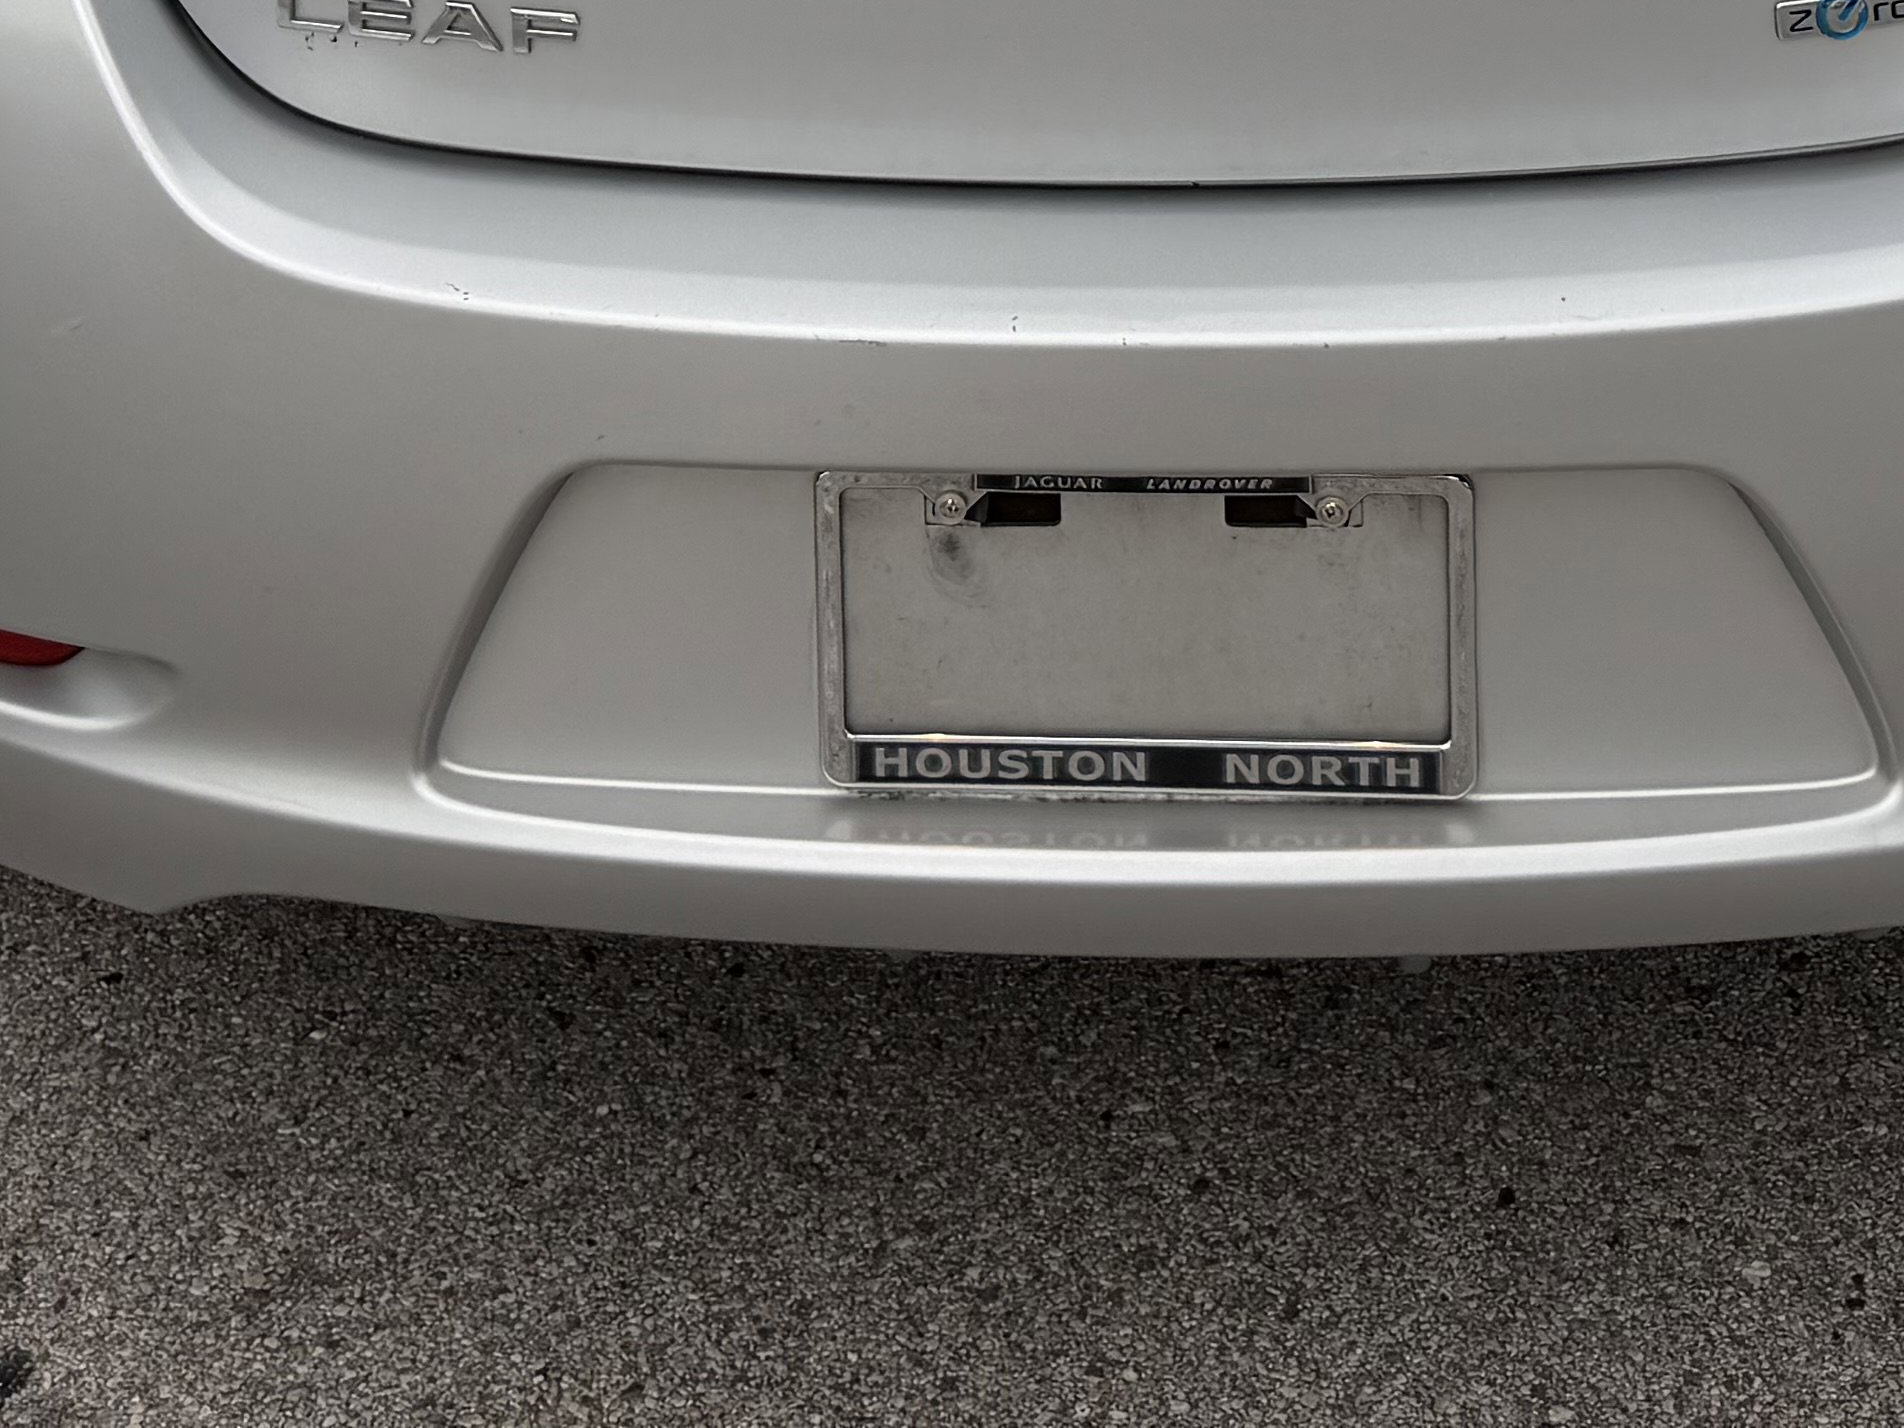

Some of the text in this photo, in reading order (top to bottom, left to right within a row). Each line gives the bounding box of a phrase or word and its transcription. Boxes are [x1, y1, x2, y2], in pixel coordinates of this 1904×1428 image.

[1014, 475, 1104, 490] JAGUAR
[873, 747, 1422, 789] HOUSTON NORTH
